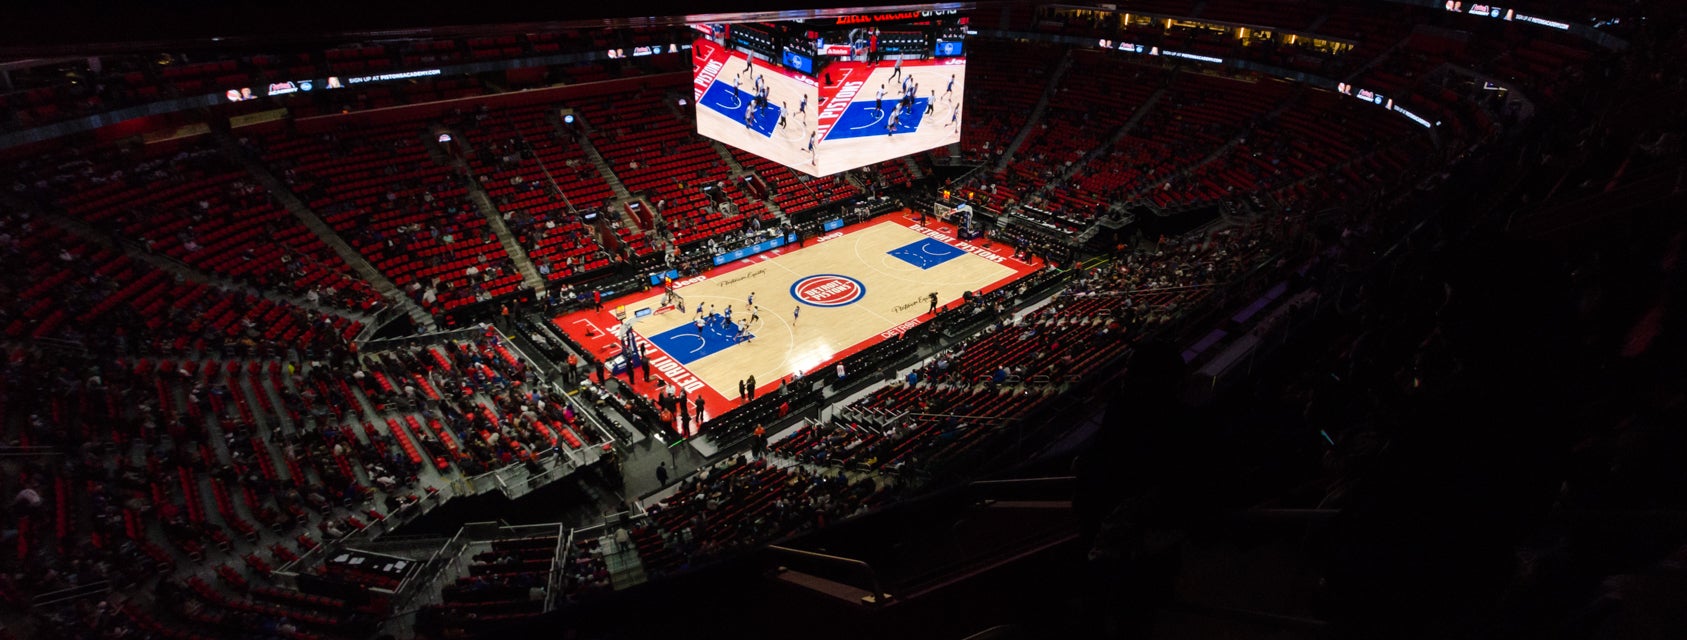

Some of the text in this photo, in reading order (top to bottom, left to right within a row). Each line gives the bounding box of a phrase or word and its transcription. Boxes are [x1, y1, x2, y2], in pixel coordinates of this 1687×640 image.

[818, 81, 864, 119] PISTONS
[817, 231, 844, 243] Jeep
[909, 223, 1007, 263] DETROIT PISTONS
[672, 275, 707, 289] Jeep
[804, 280, 842, 296] DETROIT
[810, 283, 852, 301] PISTONS
[649, 355, 705, 394] DETROIT
